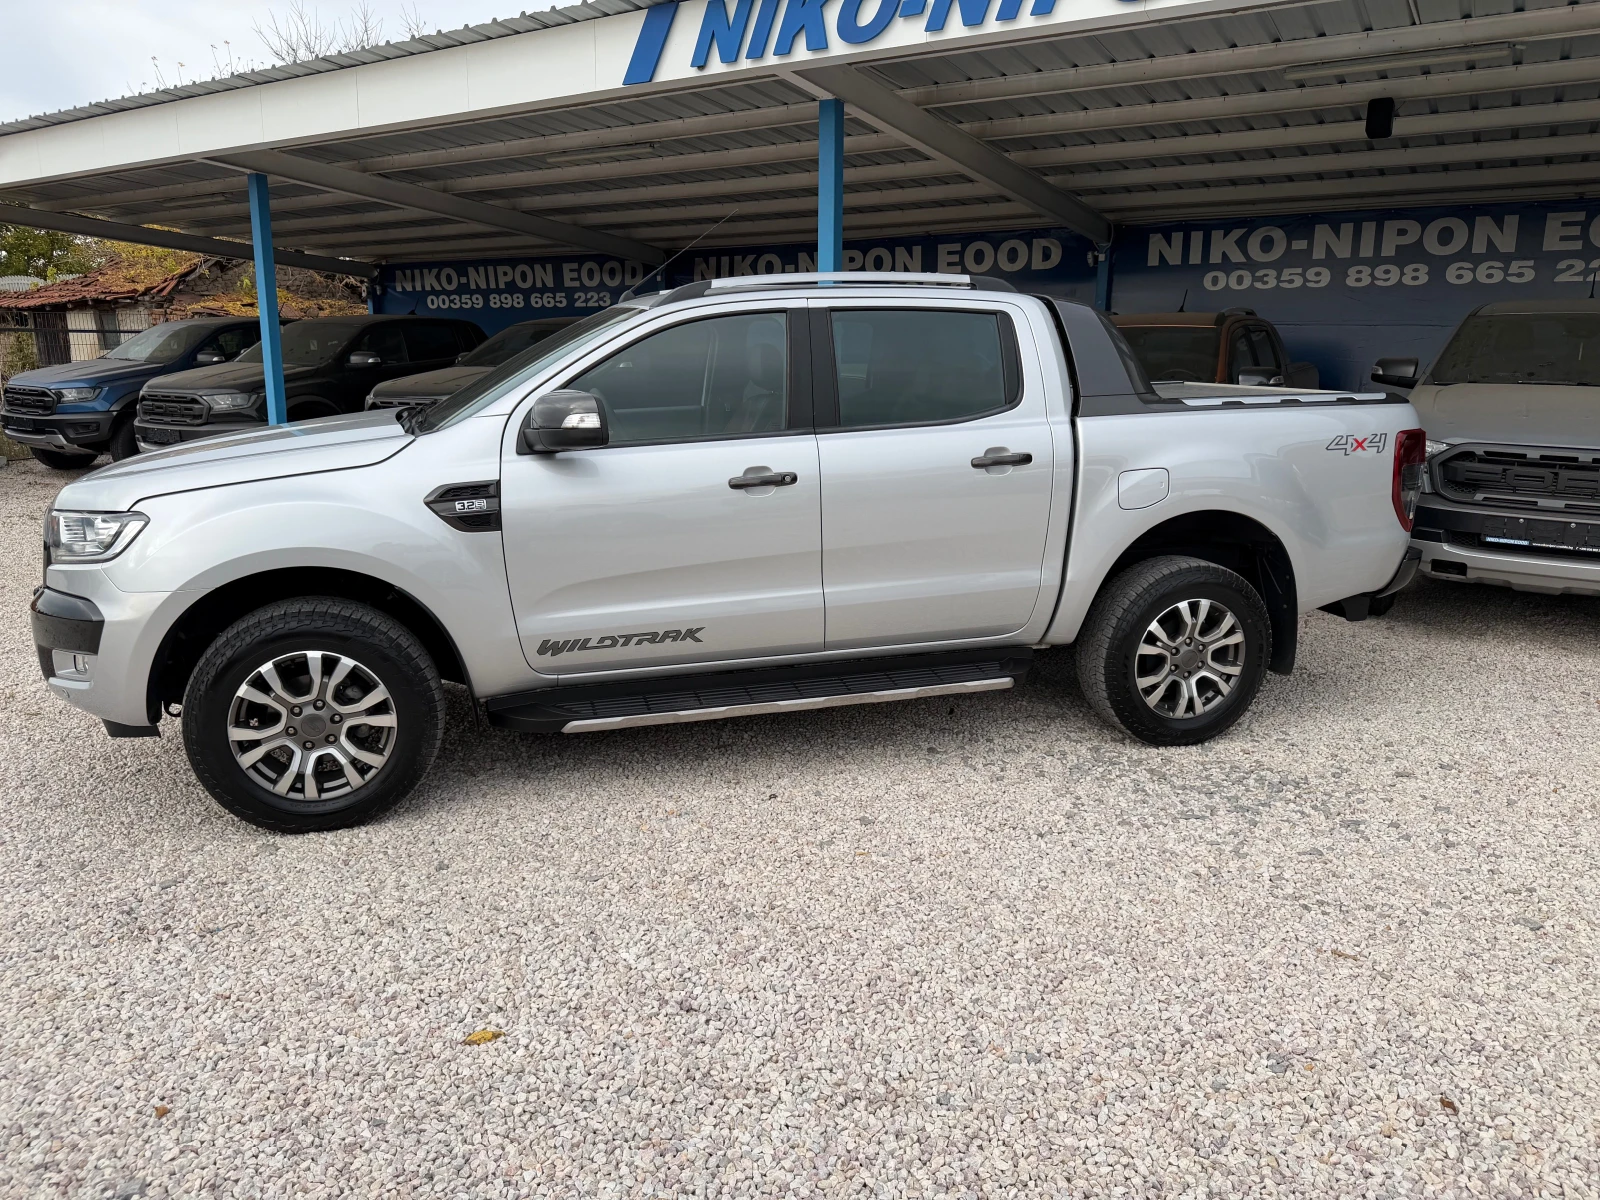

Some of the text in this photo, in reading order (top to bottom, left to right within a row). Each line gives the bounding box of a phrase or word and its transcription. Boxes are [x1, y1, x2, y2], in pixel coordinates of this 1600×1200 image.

[1147, 213, 1520, 266] NIKO-NIPON
[693, 238, 1063, 282] NIKO-NPON EOOD
[1203, 267, 1331, 291] 00359
[1345, 264, 1430, 287] 898
[1445, 260, 1536, 284] 665
[395, 261, 643, 292] NIKO-NIPON EOOD
[426, 291, 611, 310] 00359 898 665 223
[1325, 432, 1388, 456] 4x4
[536, 626, 706, 657] WILDTRAK
